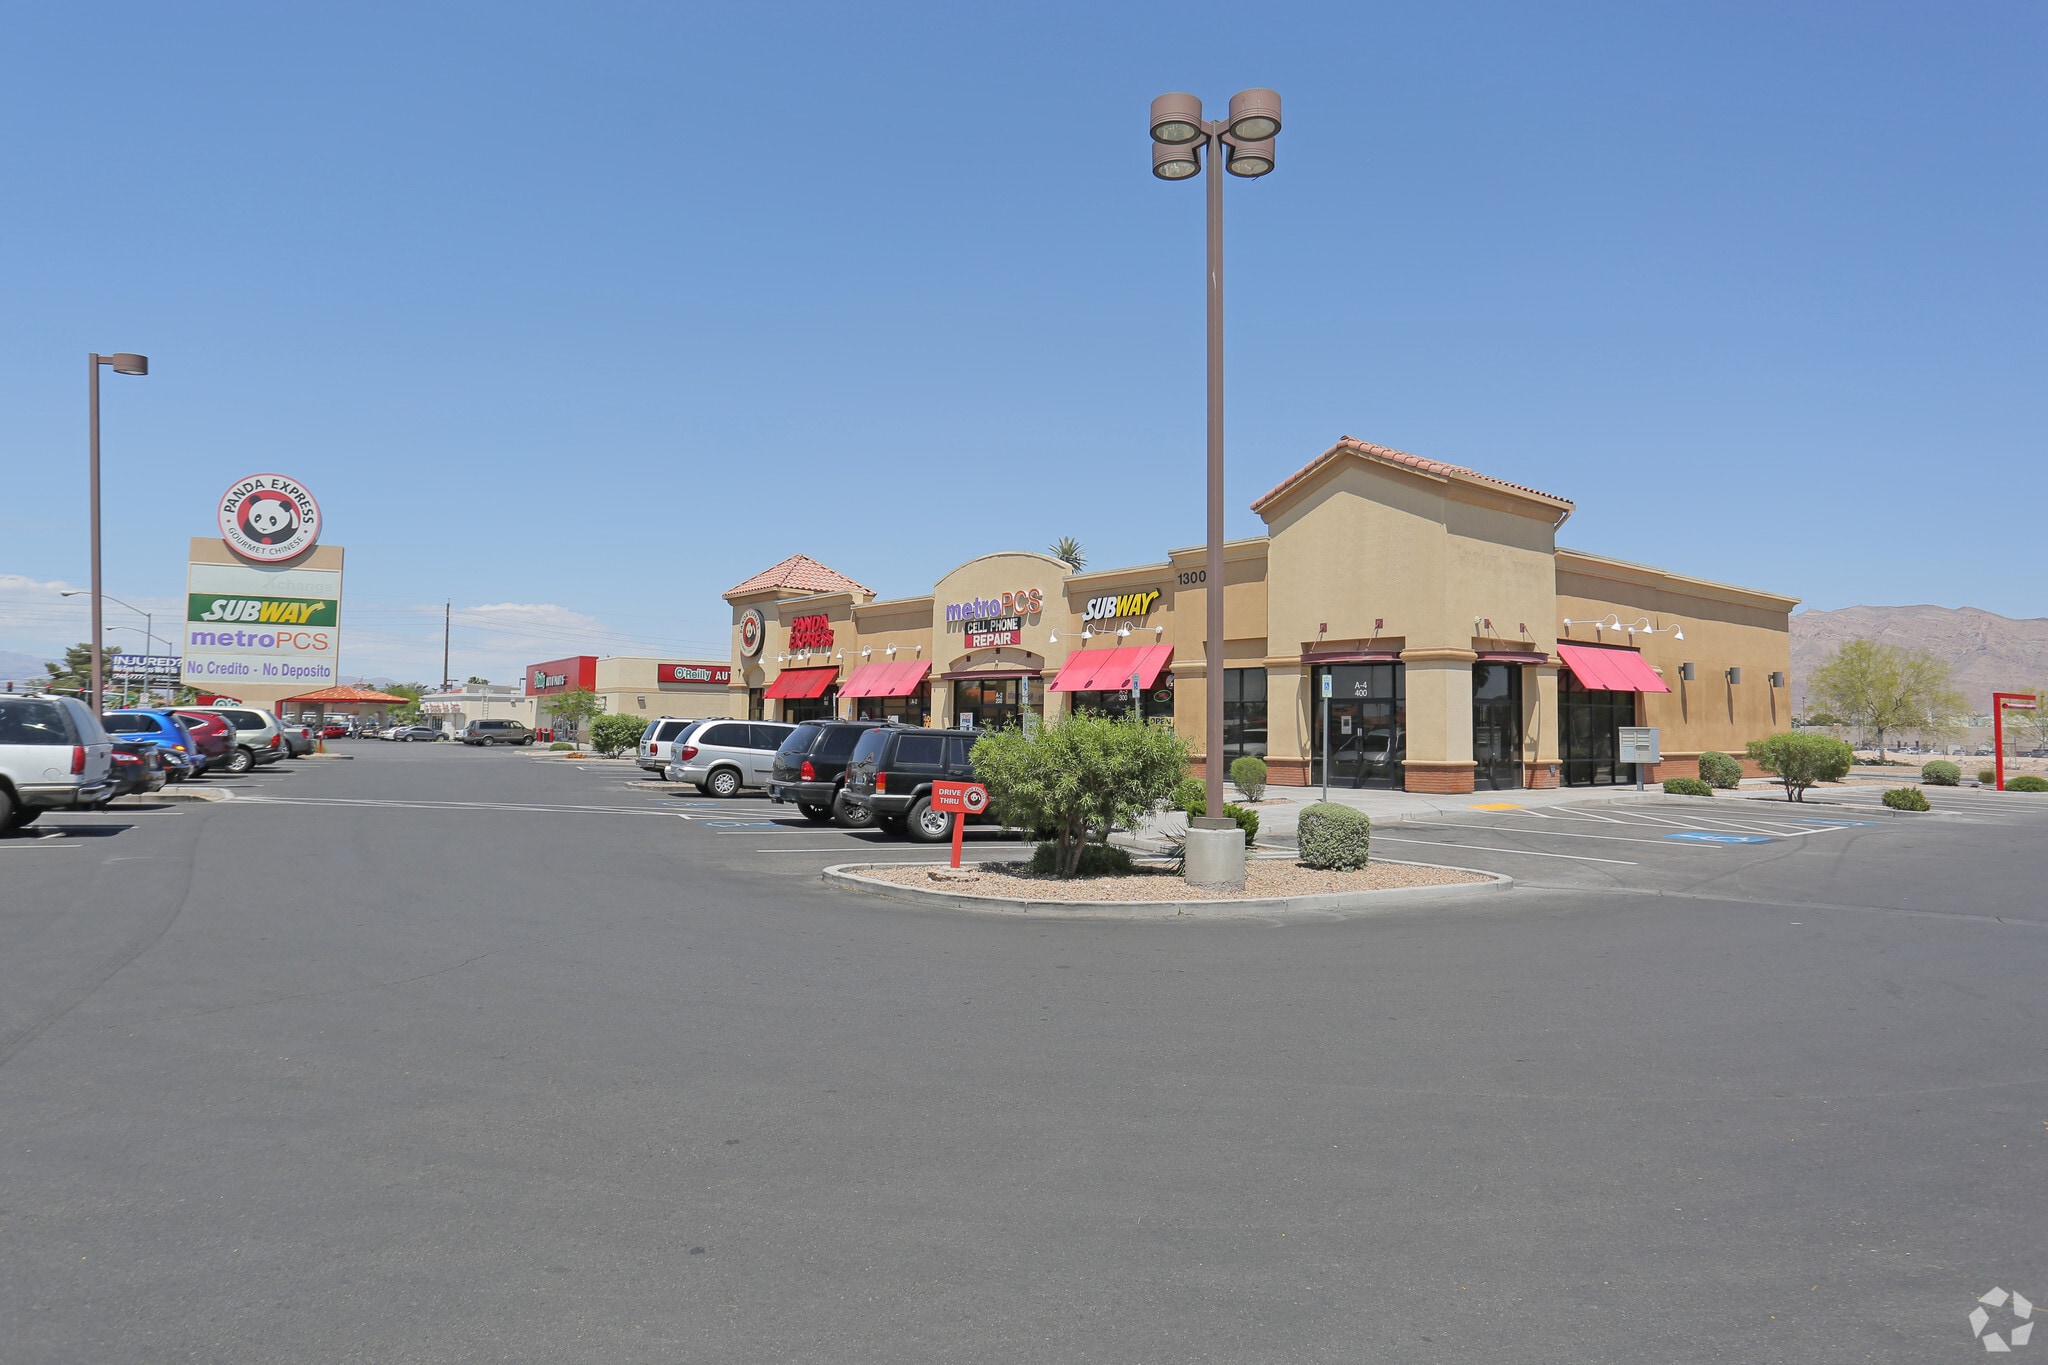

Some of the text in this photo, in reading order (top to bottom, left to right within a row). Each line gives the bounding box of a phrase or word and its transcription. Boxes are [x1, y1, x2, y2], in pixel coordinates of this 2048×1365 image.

[223, 478, 314, 524] PANDA EXPRESS
[228, 527, 304, 556] GOURMET CHINESE
[1177, 570, 1207, 586] 1300
[200, 599, 326, 624] SUBWAY
[946, 588, 1043, 621] metroPCS
[1082, 588, 1160, 621] SUBWAY
[791, 613, 829, 633] PANDA
[967, 618, 1018, 634] CELL PHONE
[190, 629, 329, 651] metroPCS
[789, 629, 834, 649] EXPRESS
[973, 632, 1012, 647] REPAIR
[187, 660, 204, 674] No
[207, 661, 250, 676] Credito
[262, 663, 281, 677] No
[281, 663, 331, 679] Deposito
[674, 666, 731, 681] O'Reilly AU
[1354, 681, 1368, 689] A-4
[1354, 689, 1368, 697] 400
[938, 788, 962, 796] DRIVE
[940, 797, 960, 805] THRU
